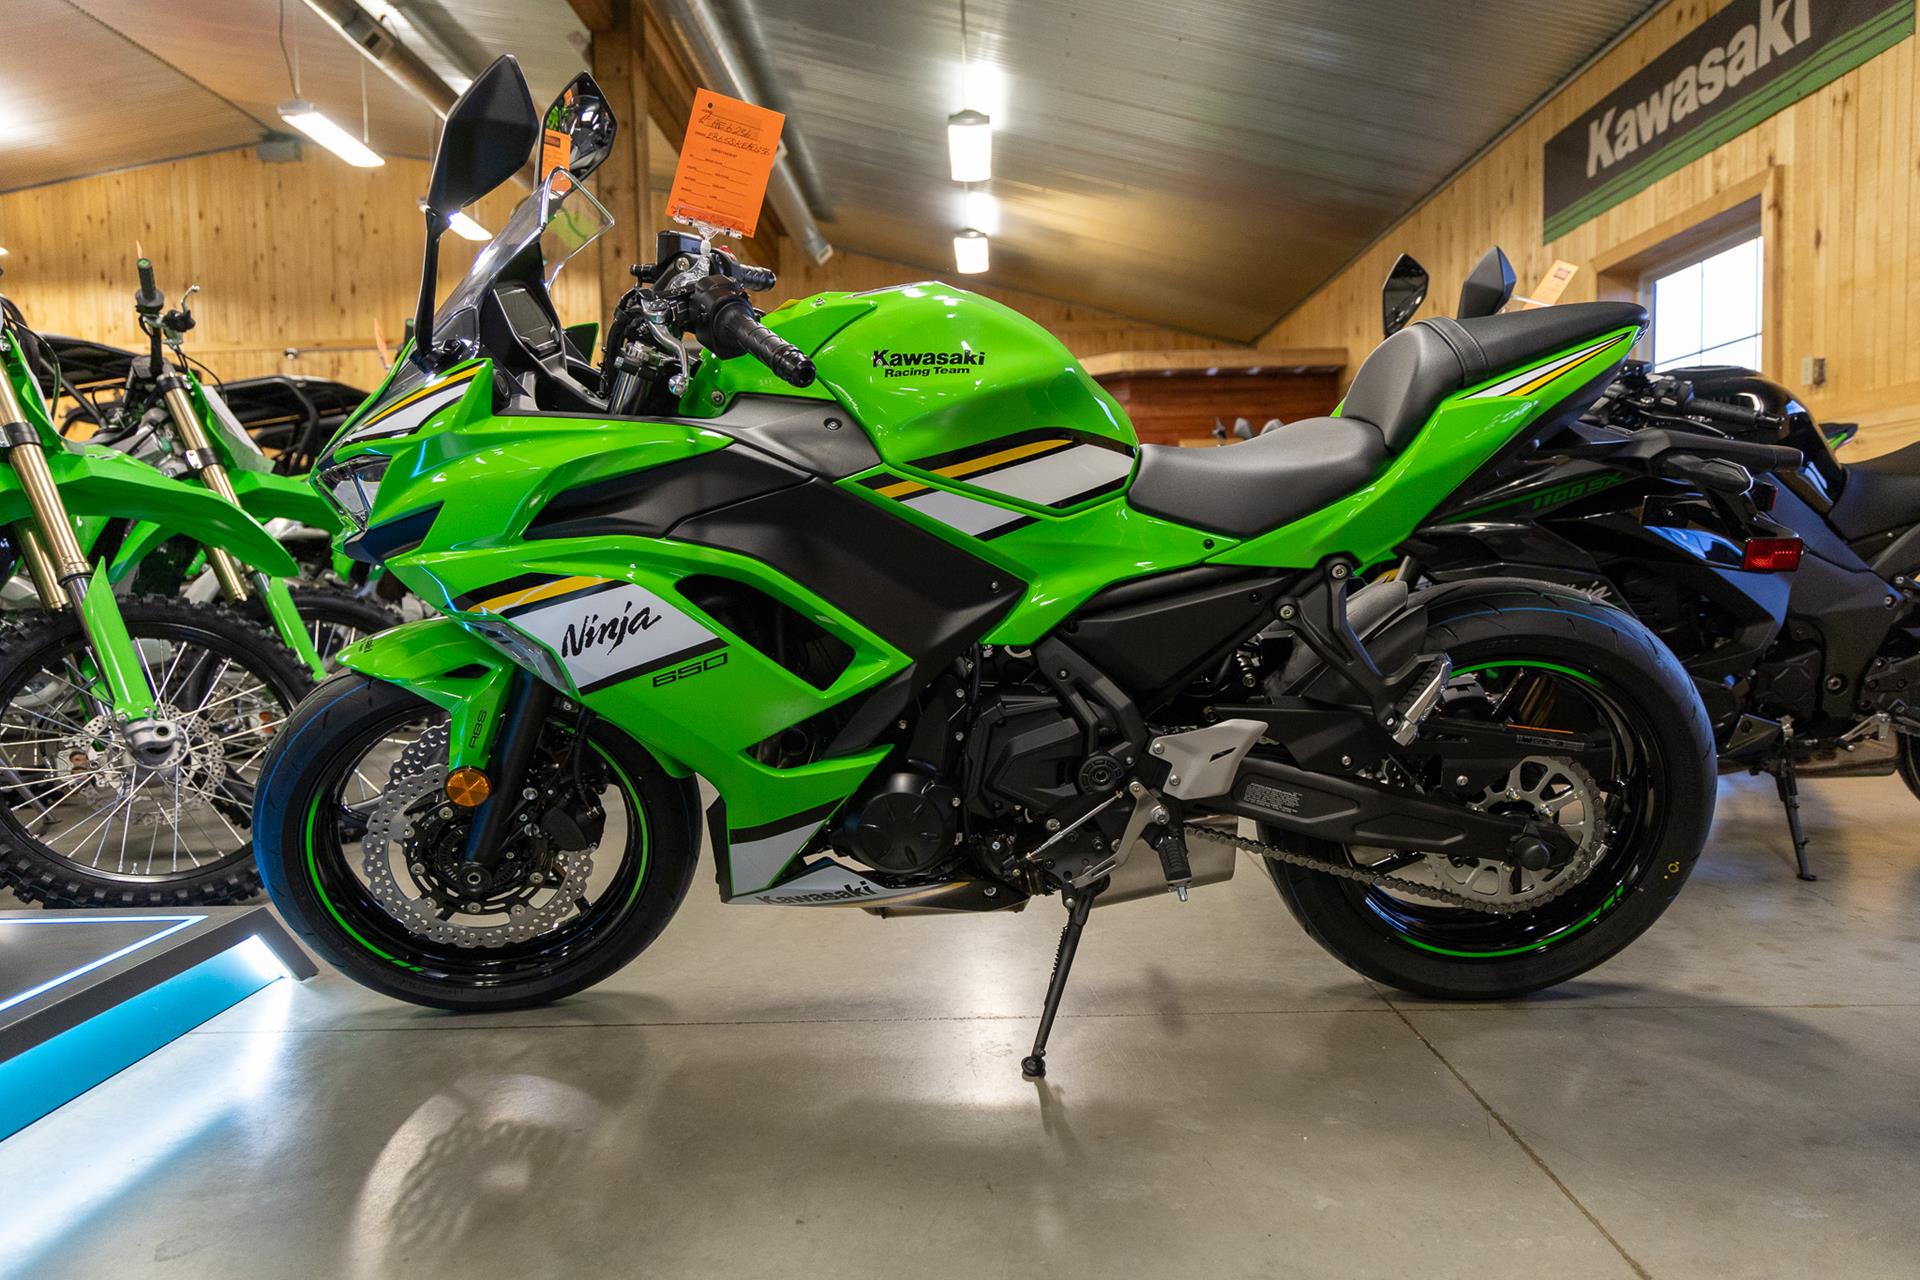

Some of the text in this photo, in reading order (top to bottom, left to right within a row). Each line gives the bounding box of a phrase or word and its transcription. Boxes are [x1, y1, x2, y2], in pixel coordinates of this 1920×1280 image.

[1586, 0, 1811, 178] Kawasaki
[872, 349, 985, 367] Kawasaki
[884, 366, 970, 378] Racing Team
[561, 600, 662, 657] Ninja
[652, 652, 728, 688] 650
[468, 709, 488, 750] ABS
[754, 880, 878, 905] Kawasaki
